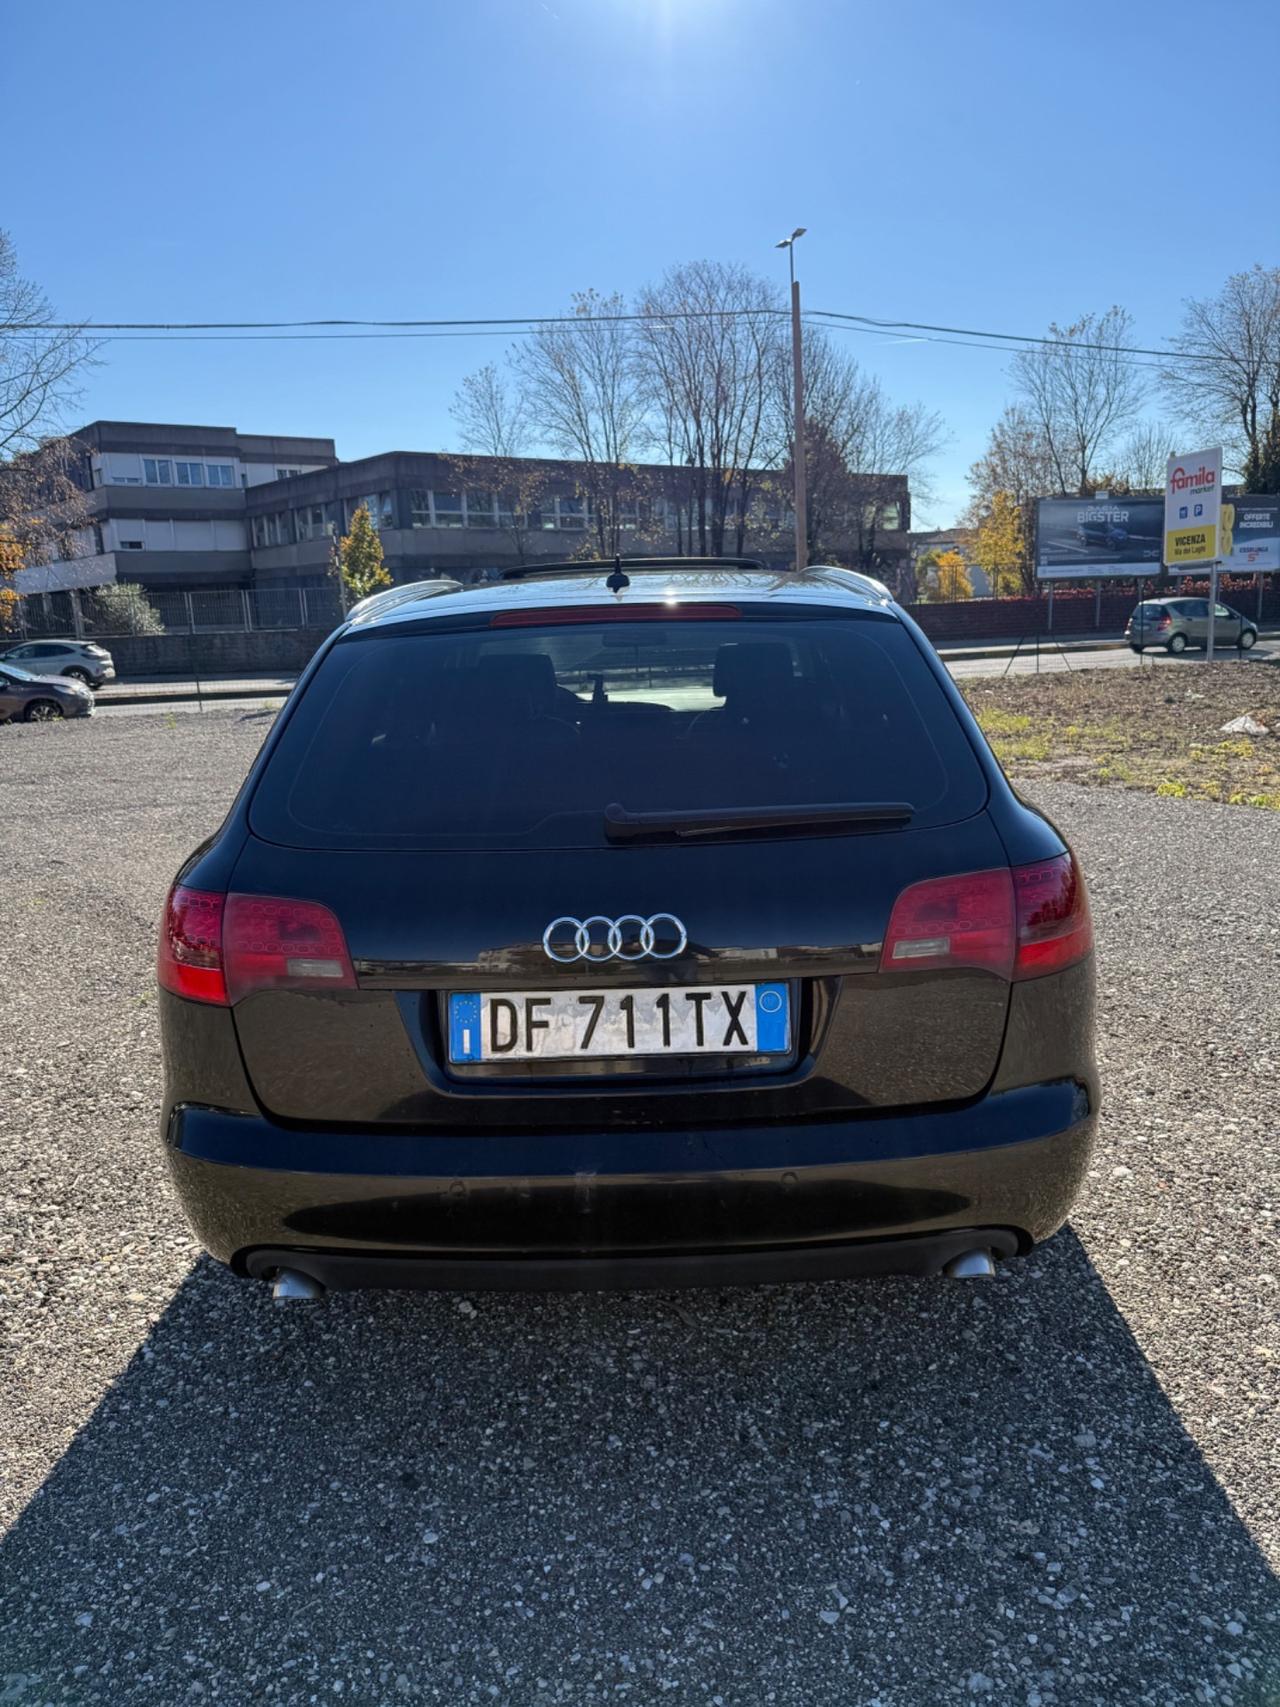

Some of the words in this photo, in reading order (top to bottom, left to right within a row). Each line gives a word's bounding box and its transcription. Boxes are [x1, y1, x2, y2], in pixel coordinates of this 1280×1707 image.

[1170, 466, 1216, 494] famila
[1190, 485, 1214, 495] market
[1077, 511, 1129, 523] BIGSTER
[1175, 533, 1206, 547] VICENZA
[489, 997, 553, 1052] DF
[577, 990, 749, 1050] 711TX
